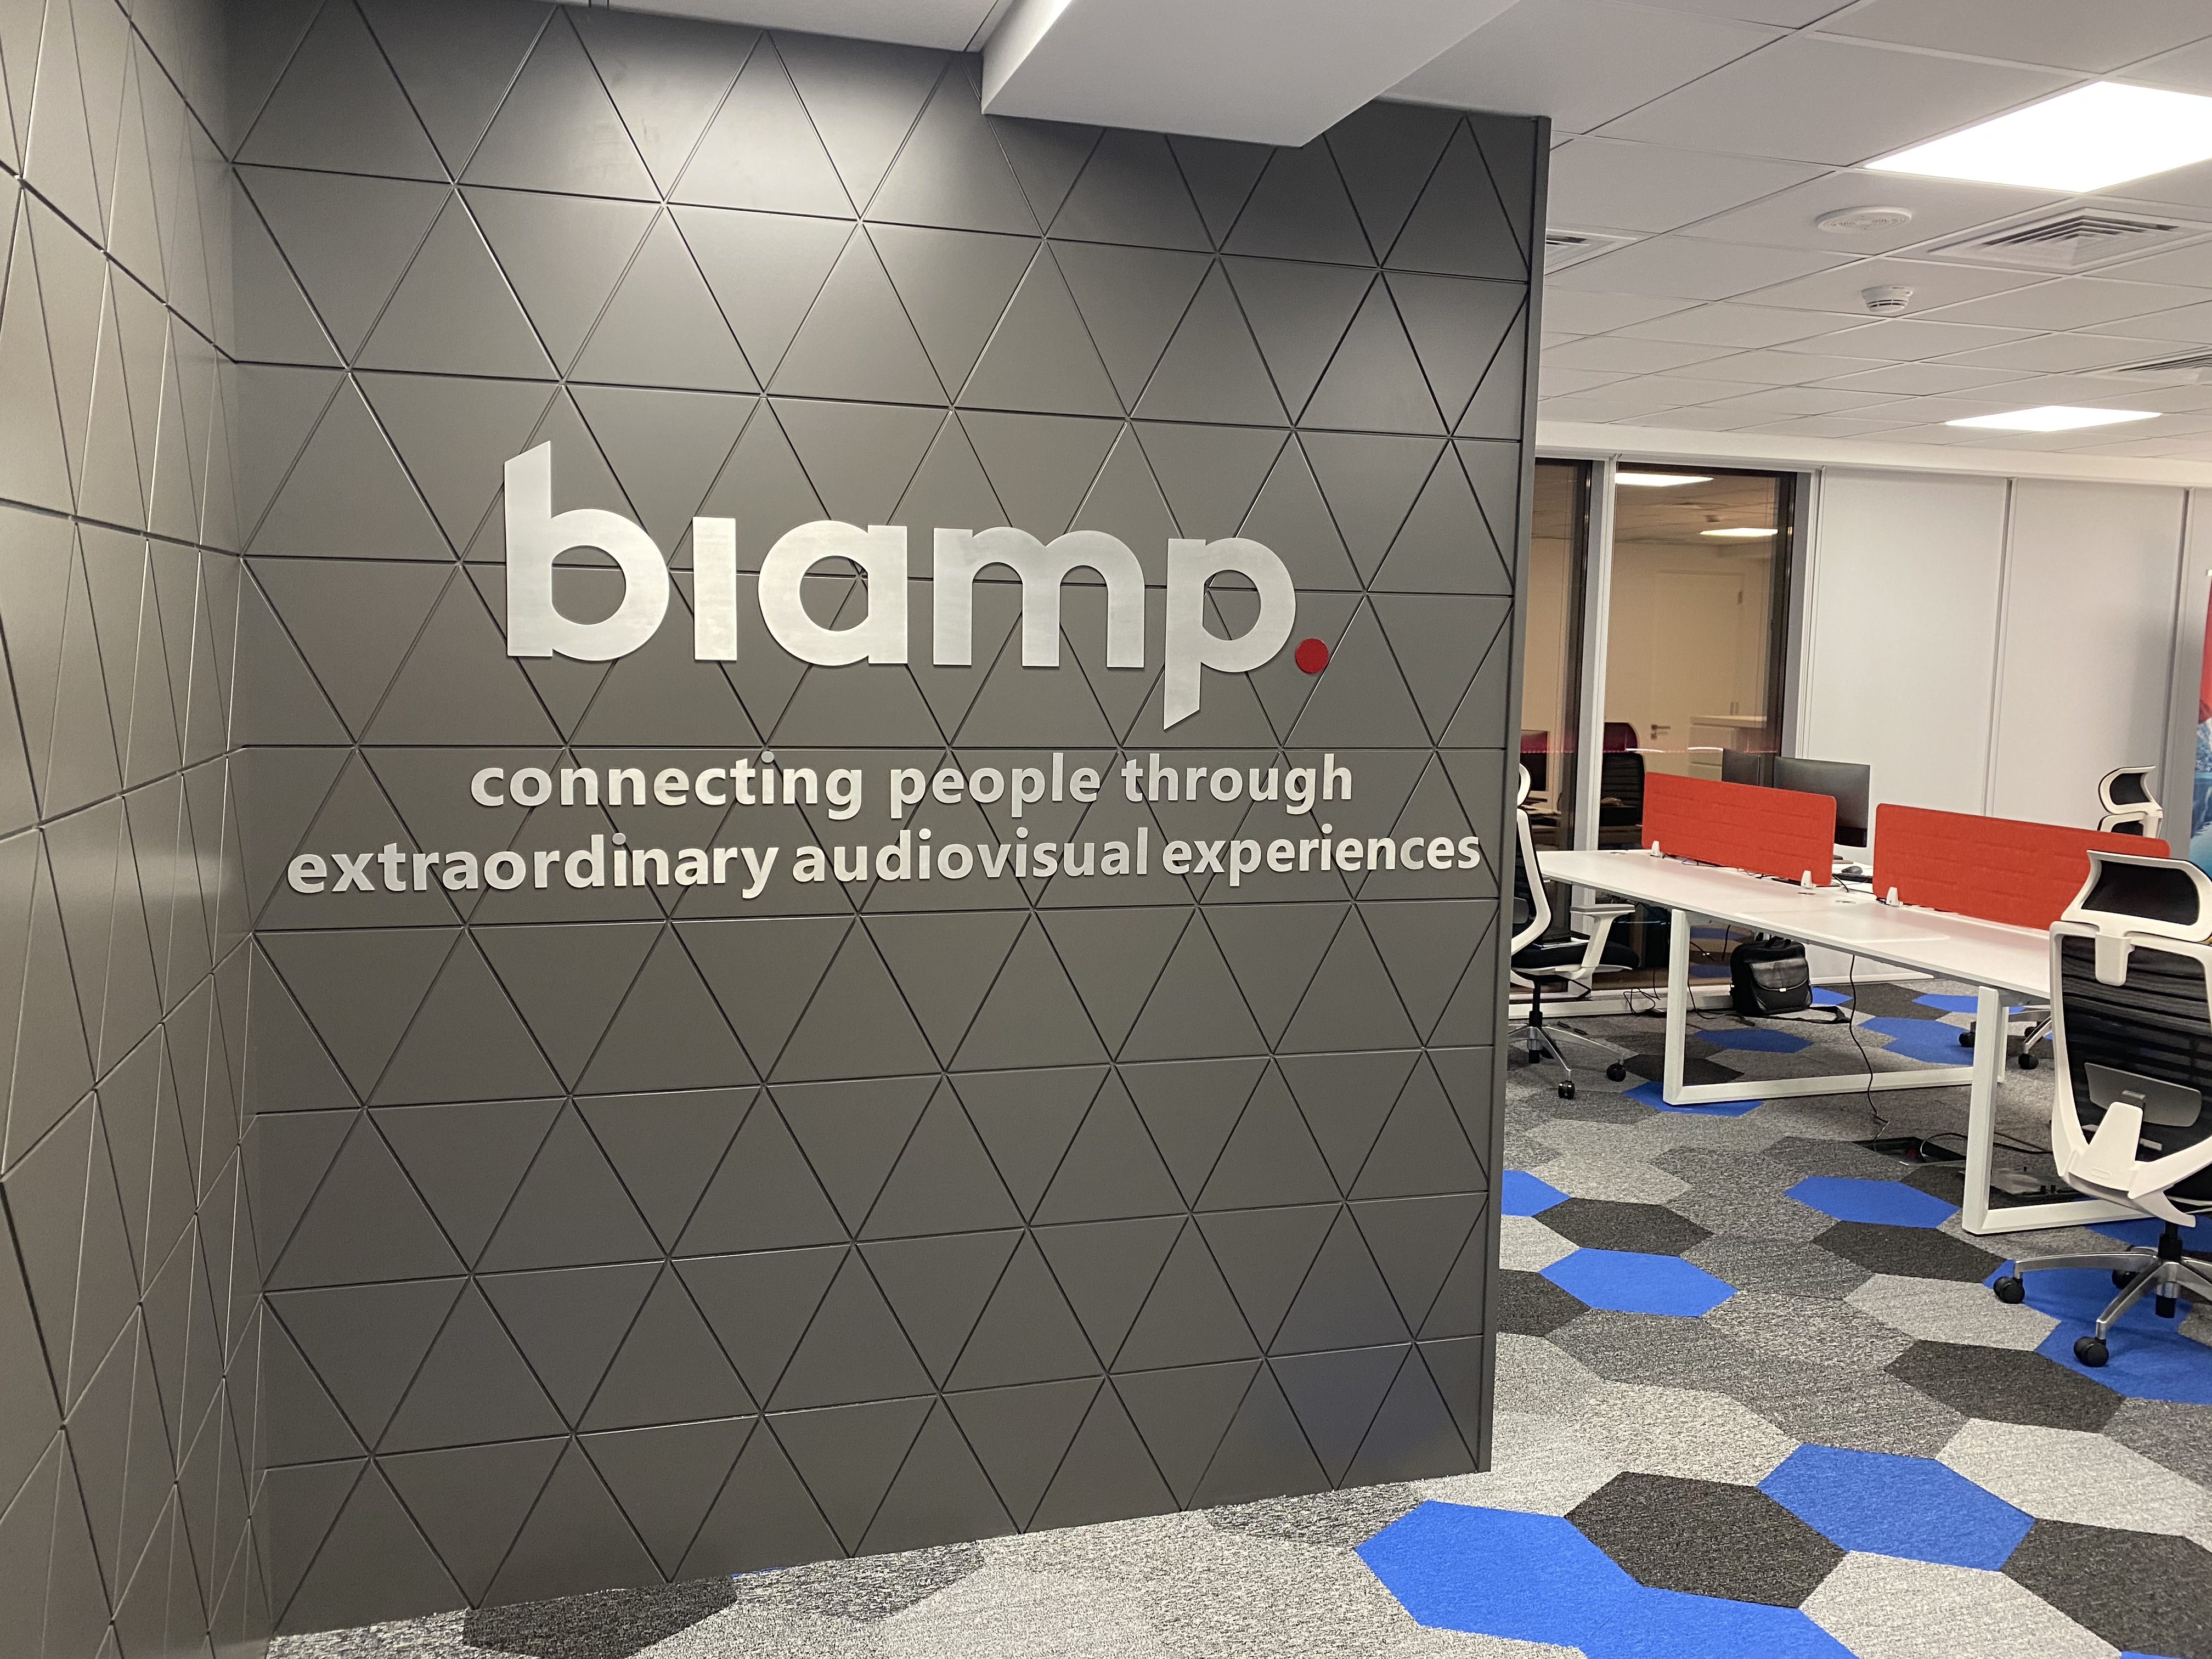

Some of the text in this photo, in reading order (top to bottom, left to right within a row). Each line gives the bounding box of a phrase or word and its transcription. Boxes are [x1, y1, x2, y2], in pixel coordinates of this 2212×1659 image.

[471, 752, 1352, 820] connecting people through
[287, 823, 1481, 898] extraordinary audiovisual experiences
